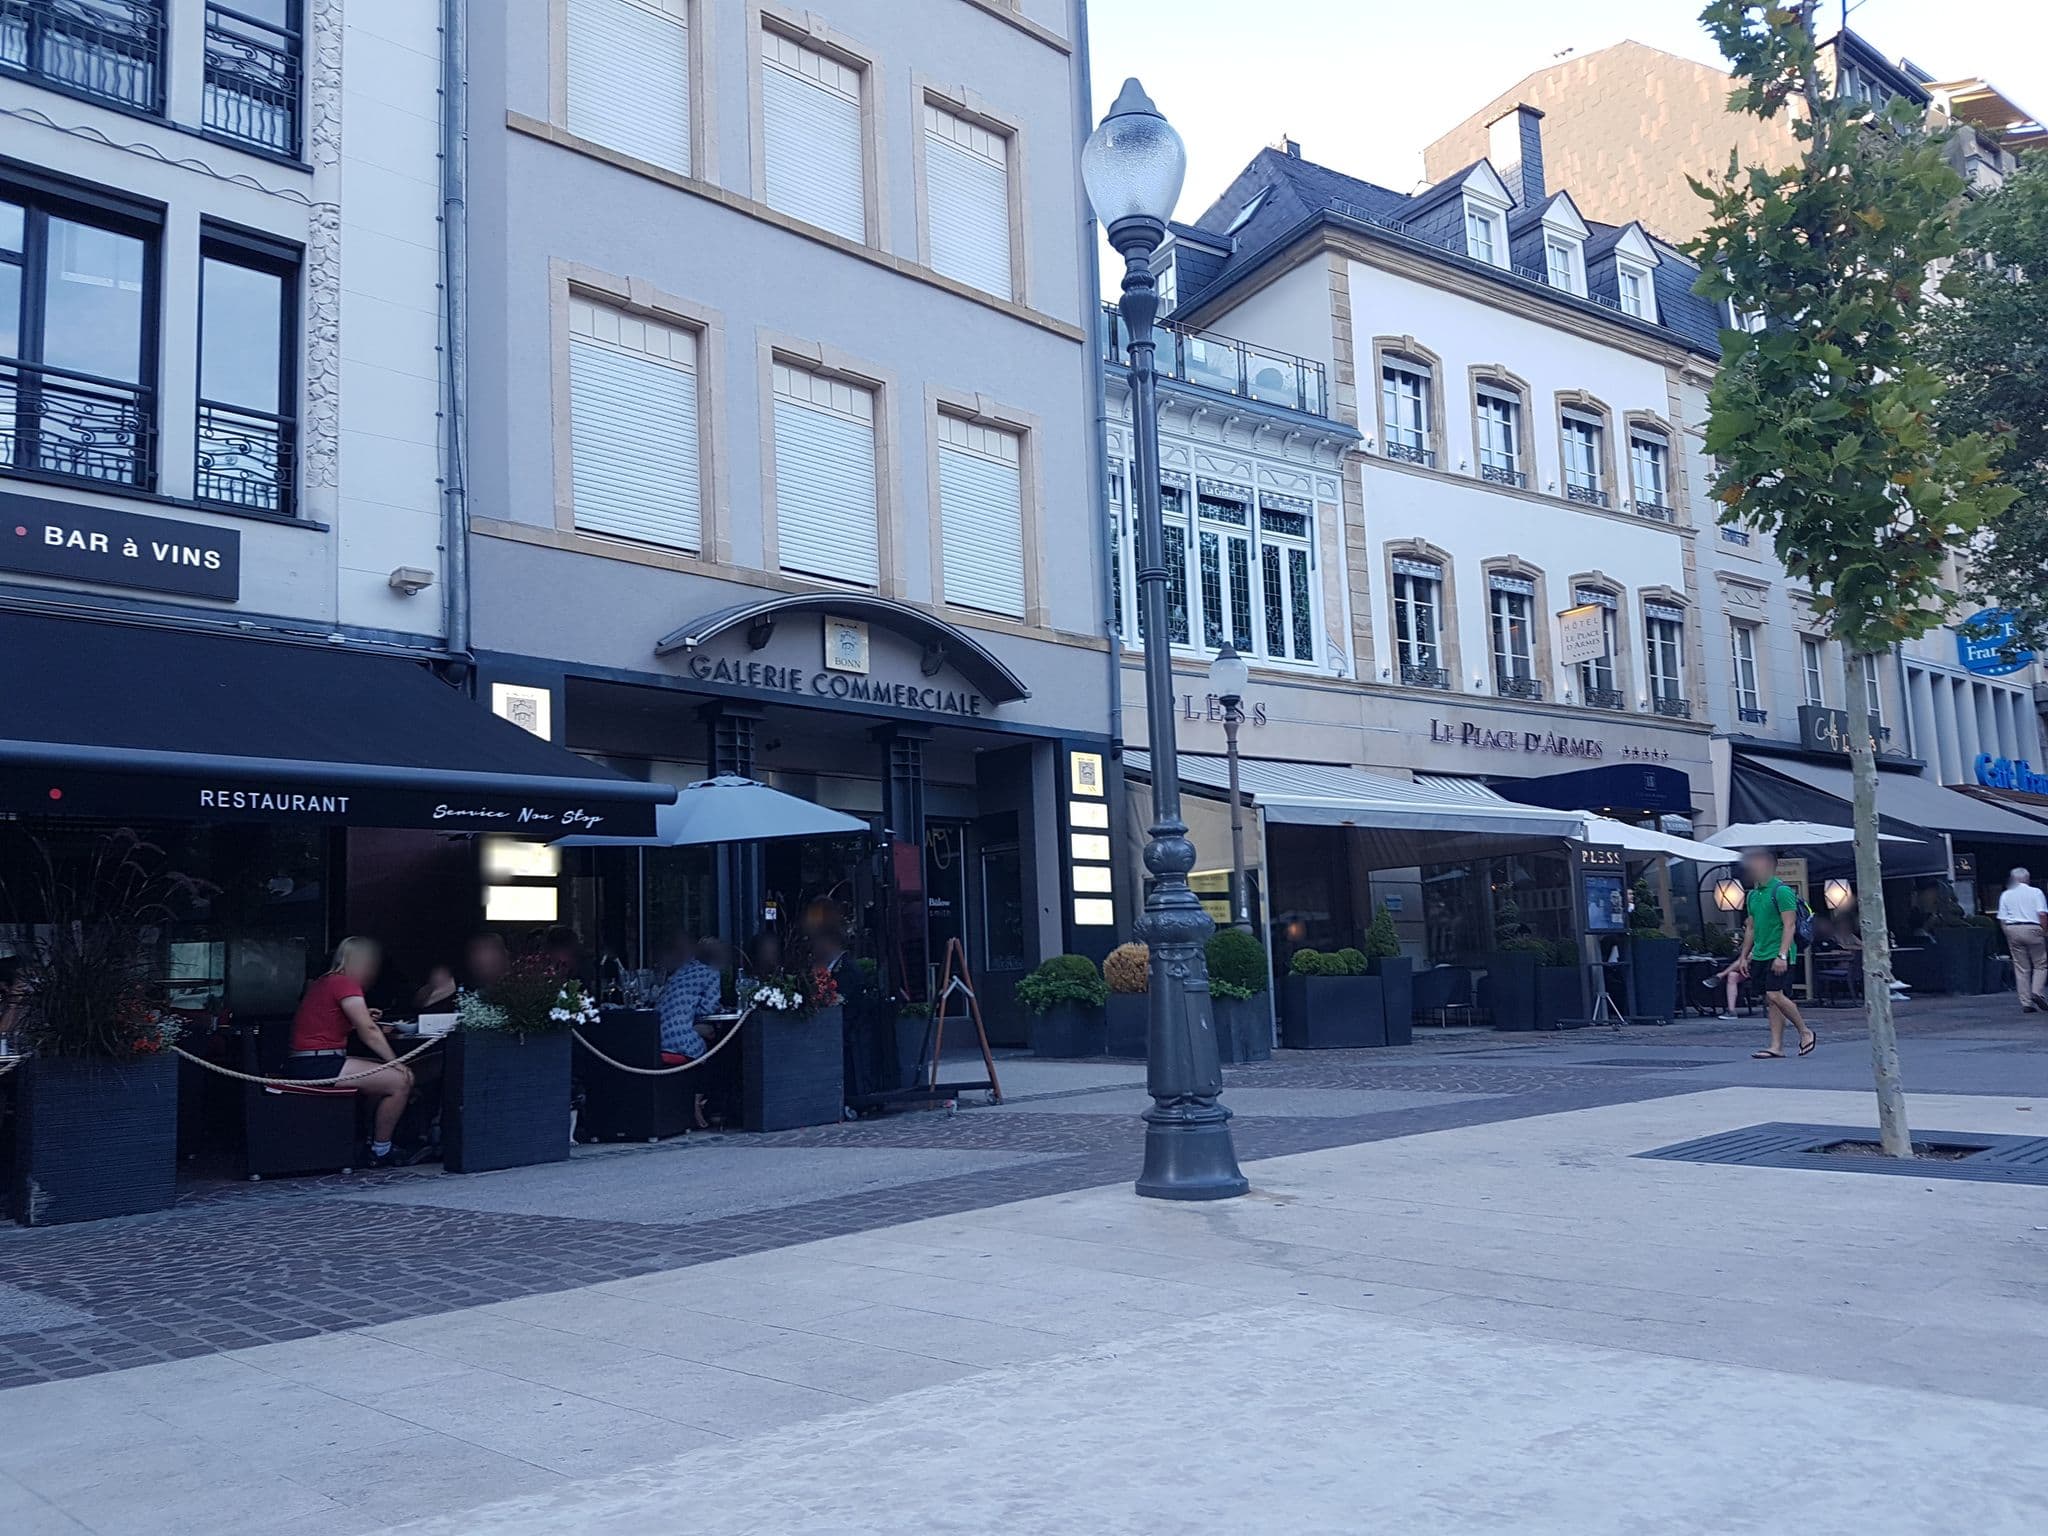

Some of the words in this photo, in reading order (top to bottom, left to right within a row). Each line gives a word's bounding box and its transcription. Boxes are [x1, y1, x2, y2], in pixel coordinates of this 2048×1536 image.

[44, 525, 109, 553] BAR
[122, 537, 139, 558] à
[152, 541, 222, 570] VINS
[688, 654, 803, 692] GALERIE
[812, 672, 981, 717] COMMERCIALE
[200, 789, 350, 813] RESTAURANT
[433, 804, 510, 819] Service
[517, 807, 554, 823] Non
[561, 809, 605, 829] Stop
